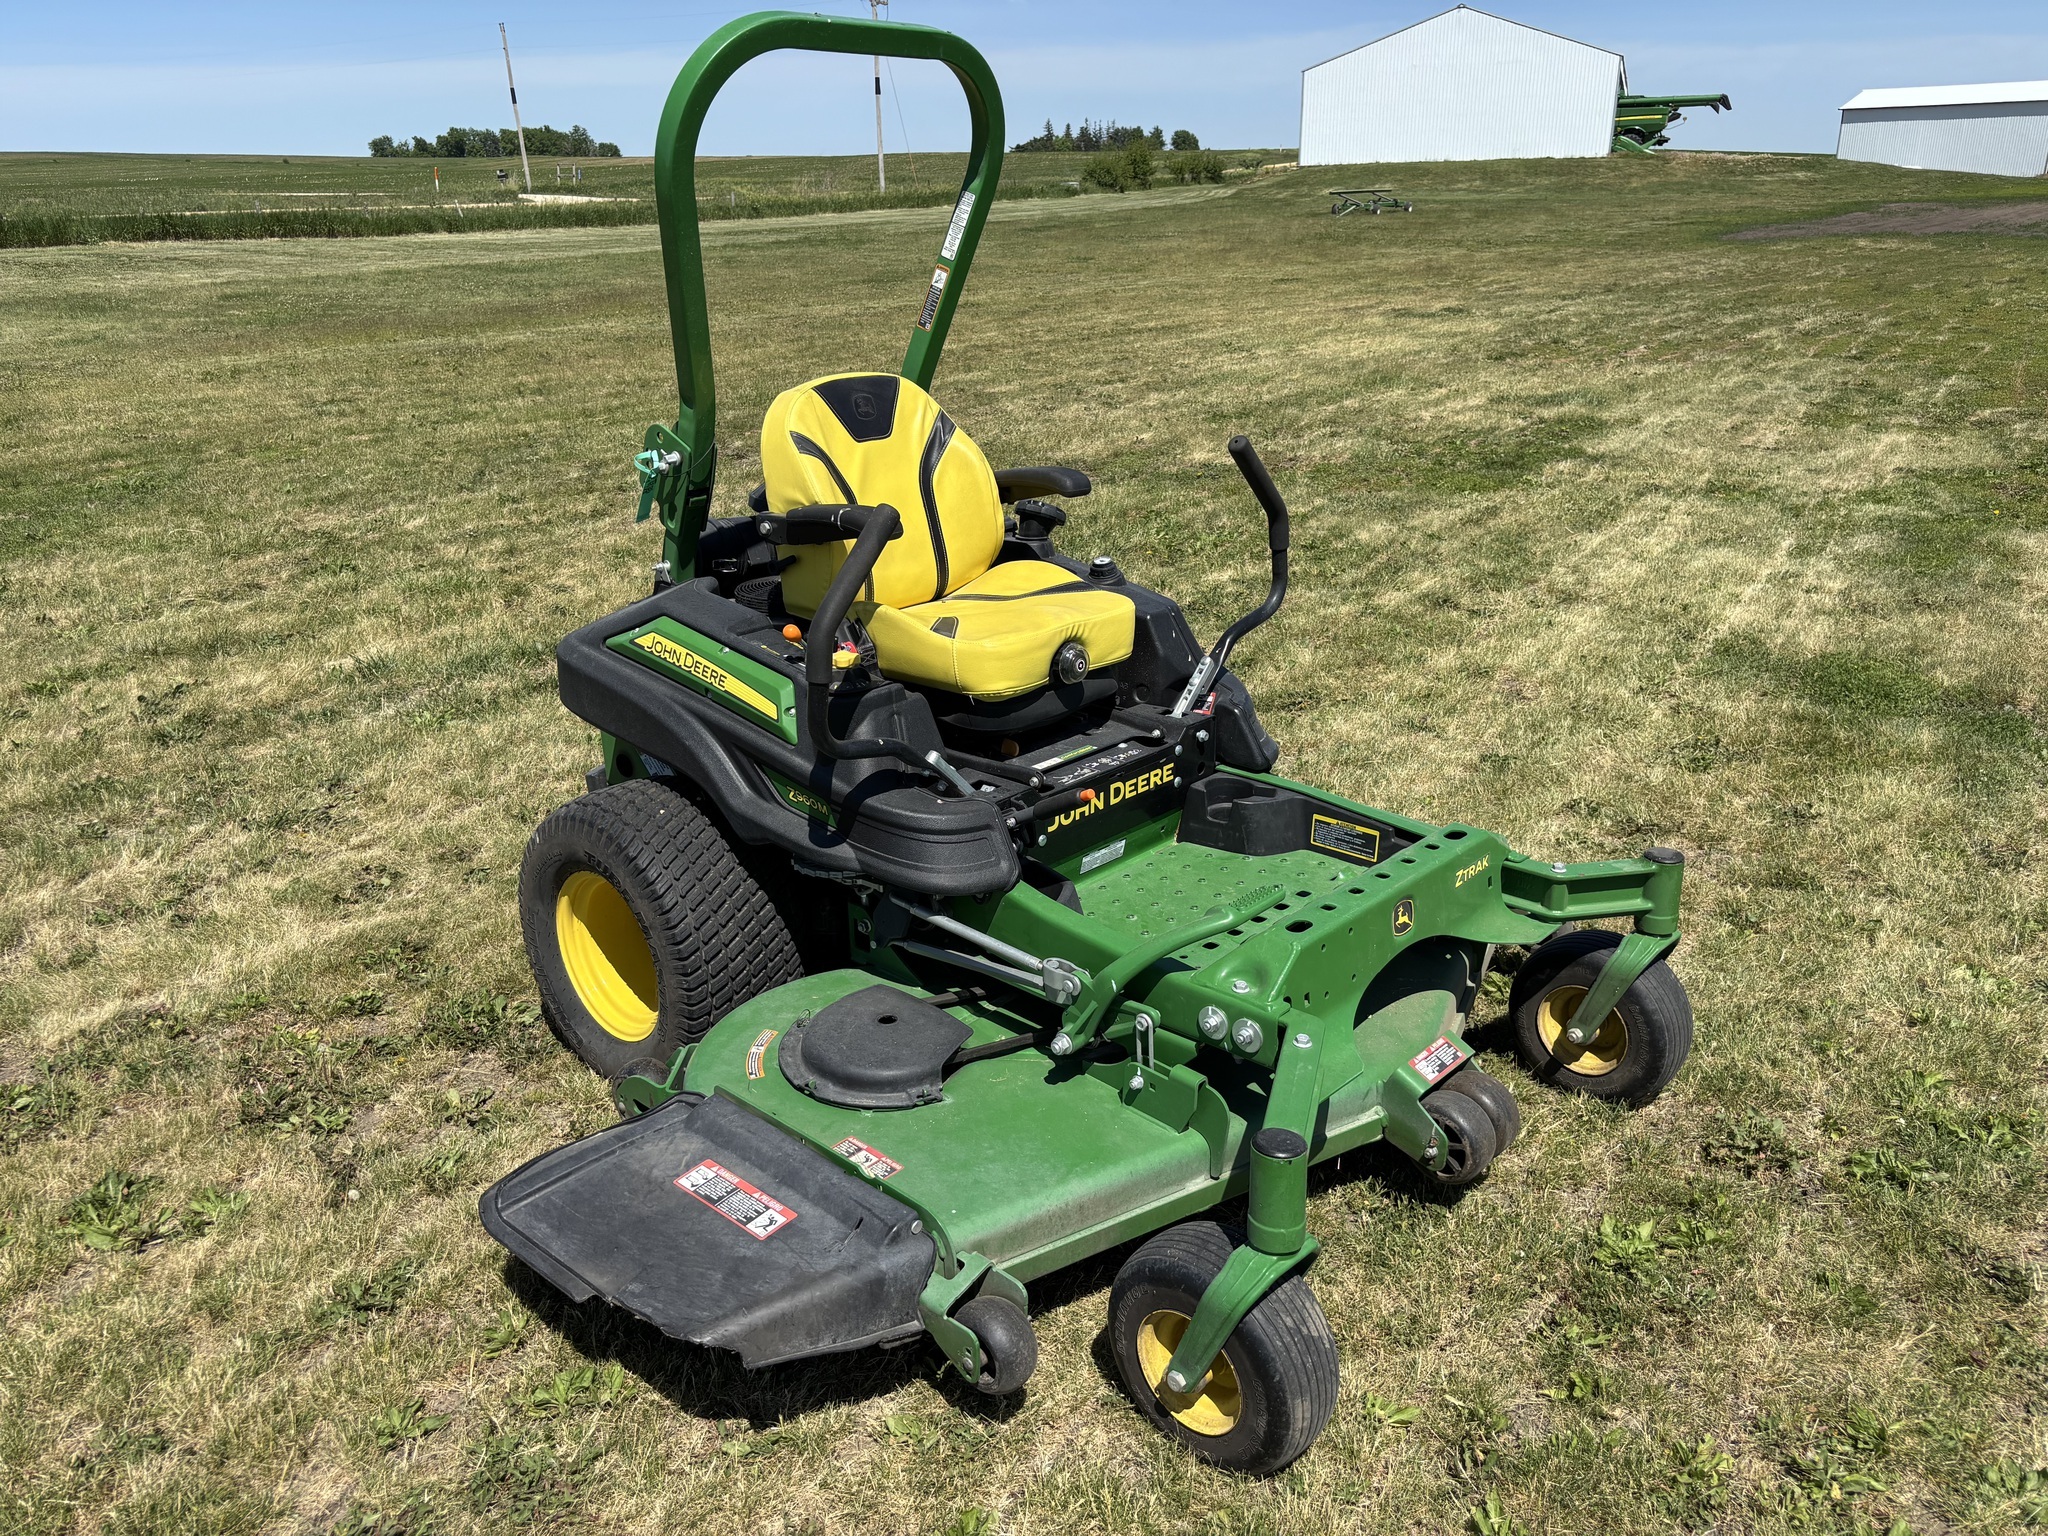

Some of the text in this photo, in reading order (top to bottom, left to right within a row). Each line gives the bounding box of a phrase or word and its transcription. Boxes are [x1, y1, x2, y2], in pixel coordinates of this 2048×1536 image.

[646, 636, 727, 689] JOHN DEERE
[786, 785, 828, 815] Z960M
[1048, 792, 1104, 833] JOHN
[1110, 763, 1174, 806] DEERE
[583, 849, 636, 905] TURF
[1455, 855, 1489, 888] ZTRAK
[717, 1168, 740, 1184] DANGER
[758, 1195, 784, 1212] PELIGRO
[1239, 1378, 1269, 1461] CARLISLE
